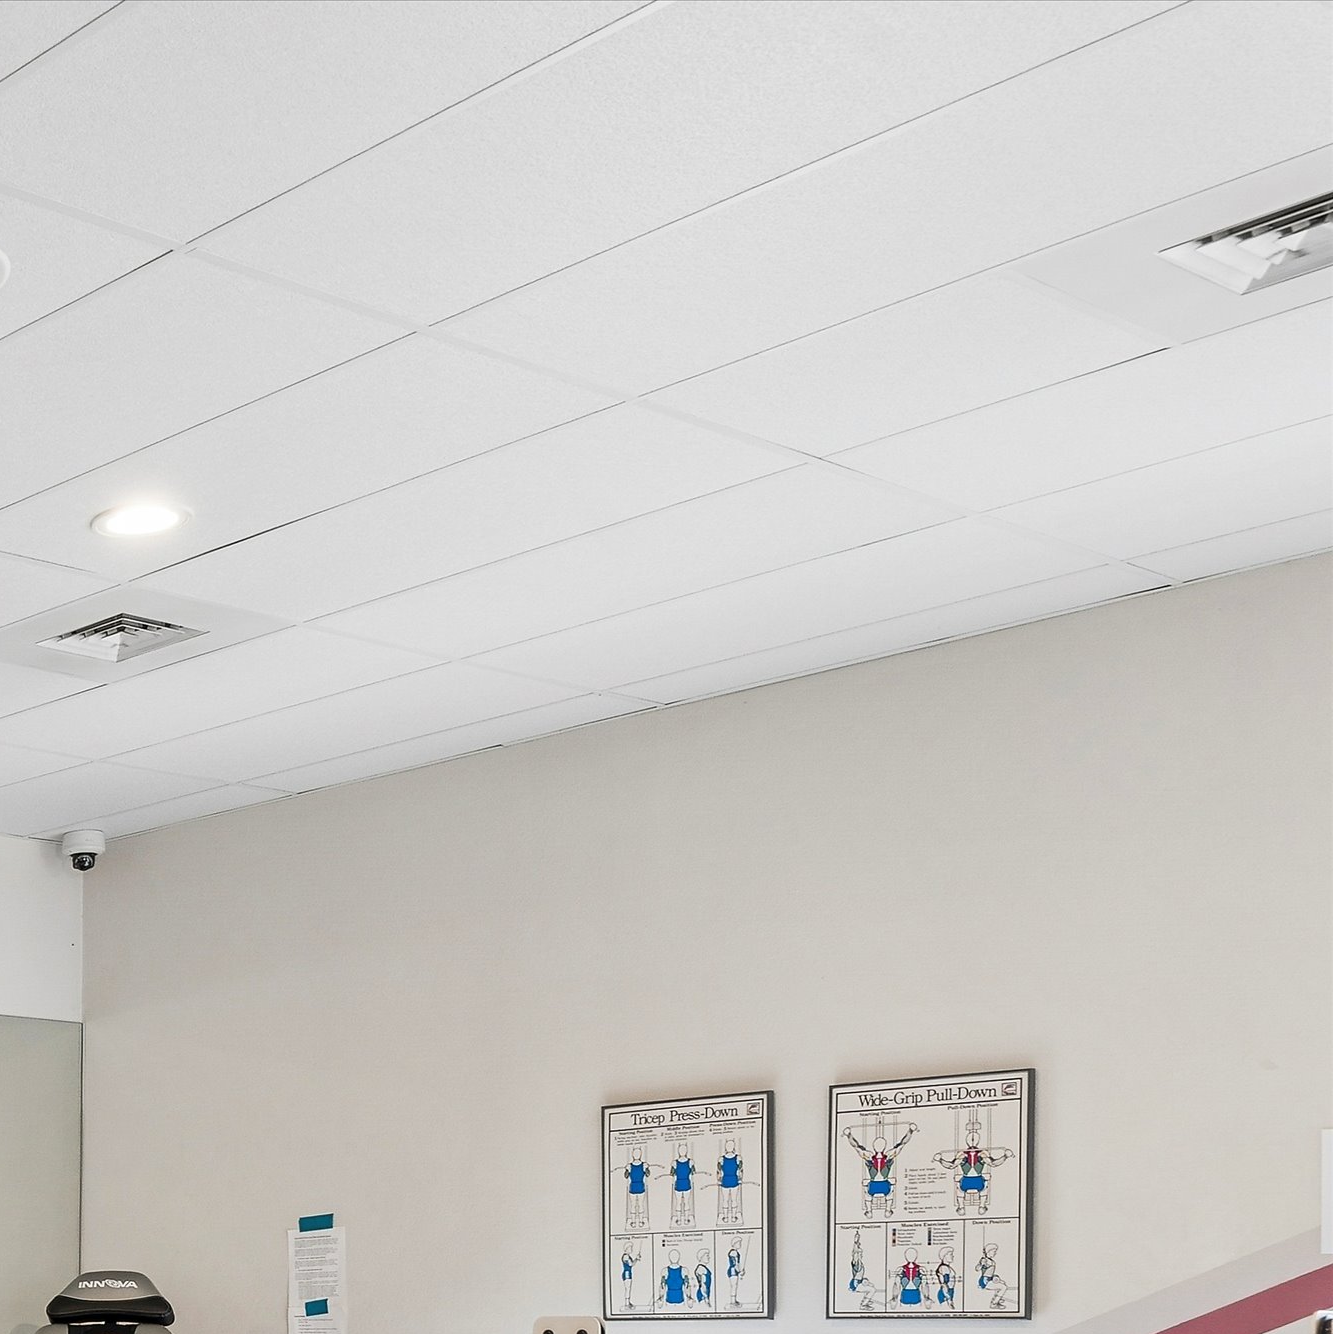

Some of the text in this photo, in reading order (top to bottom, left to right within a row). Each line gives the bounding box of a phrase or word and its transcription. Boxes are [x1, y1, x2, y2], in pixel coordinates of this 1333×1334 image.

[858, 1087, 997, 1108] Wide-Grip Pull-Down
[631, 1107, 738, 1126] Tricep Press-Down
[78, 1279, 139, 1289] INNOVA
